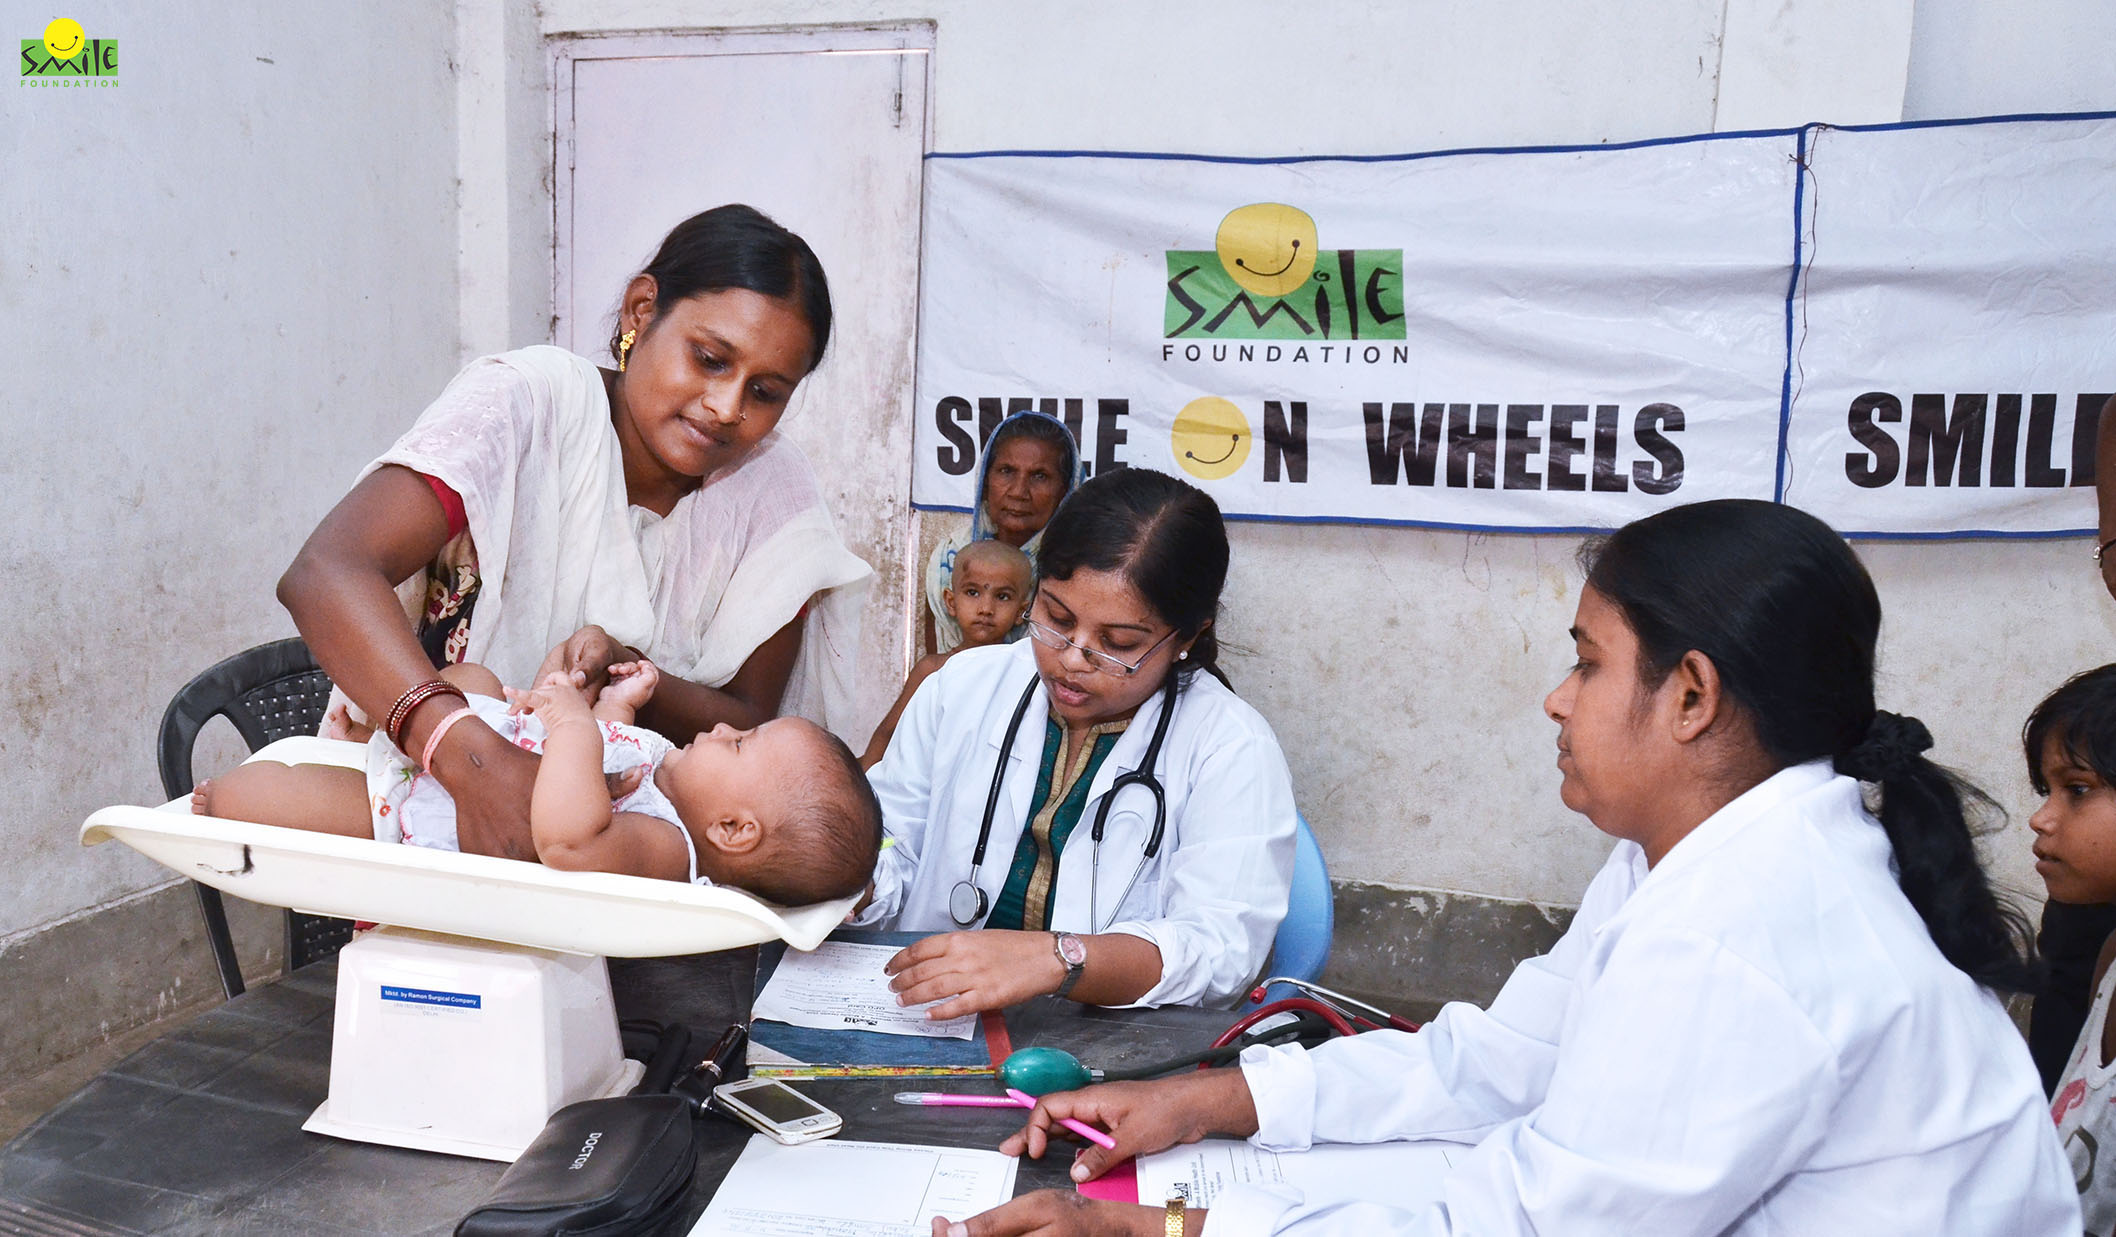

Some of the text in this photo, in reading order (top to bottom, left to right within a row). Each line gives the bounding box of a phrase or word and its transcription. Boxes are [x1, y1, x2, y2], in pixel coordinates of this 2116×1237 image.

[1162, 344, 1409, 364] FOUNDATION
[935, 396, 1129, 476] SLE
[1362, 402, 1686, 495] WHEELS
[401, 991, 407, 999] by
[408, 992, 427, 1000] Ramon
[428, 994, 450, 1002] Surgical
[451, 996, 477, 1005] Company
[568, 1132, 603, 1170] DOCTOR
